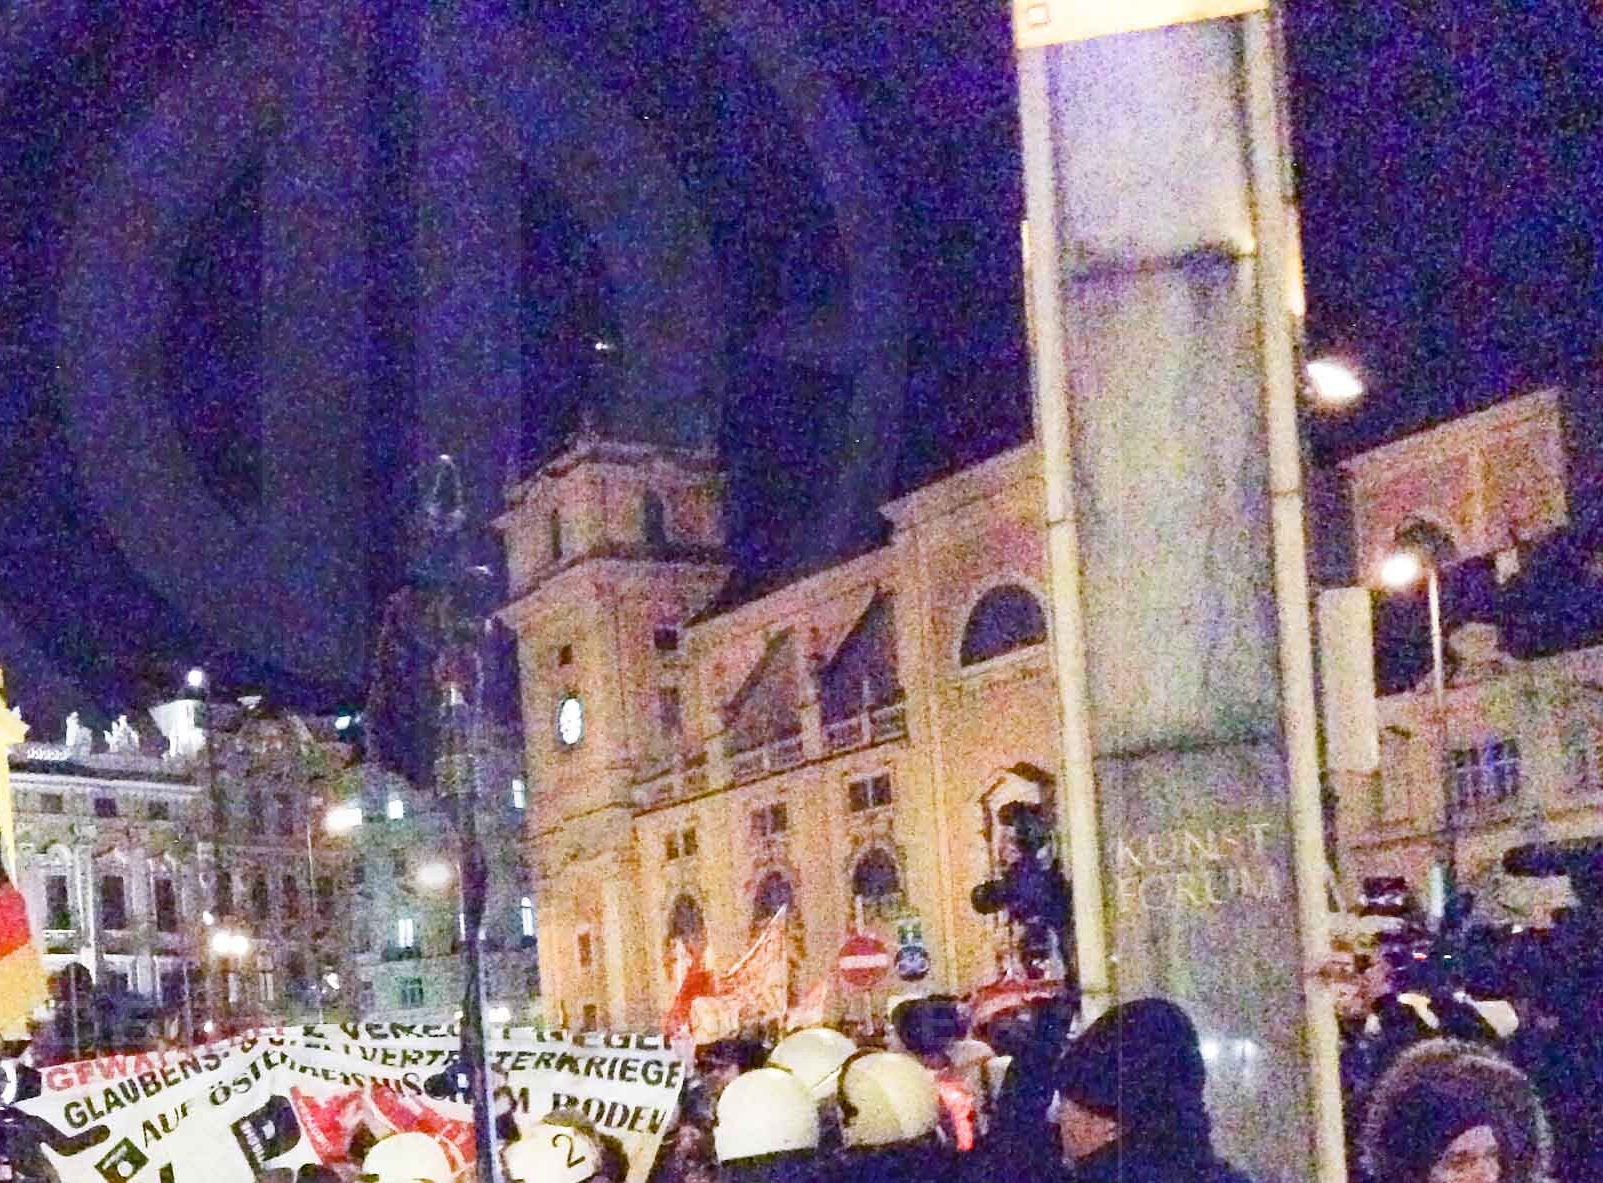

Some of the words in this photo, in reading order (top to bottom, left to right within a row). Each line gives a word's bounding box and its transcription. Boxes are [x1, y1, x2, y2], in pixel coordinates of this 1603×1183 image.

[1112, 822, 1271, 869] KUNST
[1115, 865, 1282, 914] FORUM
[551, 1132, 586, 1169] 2
